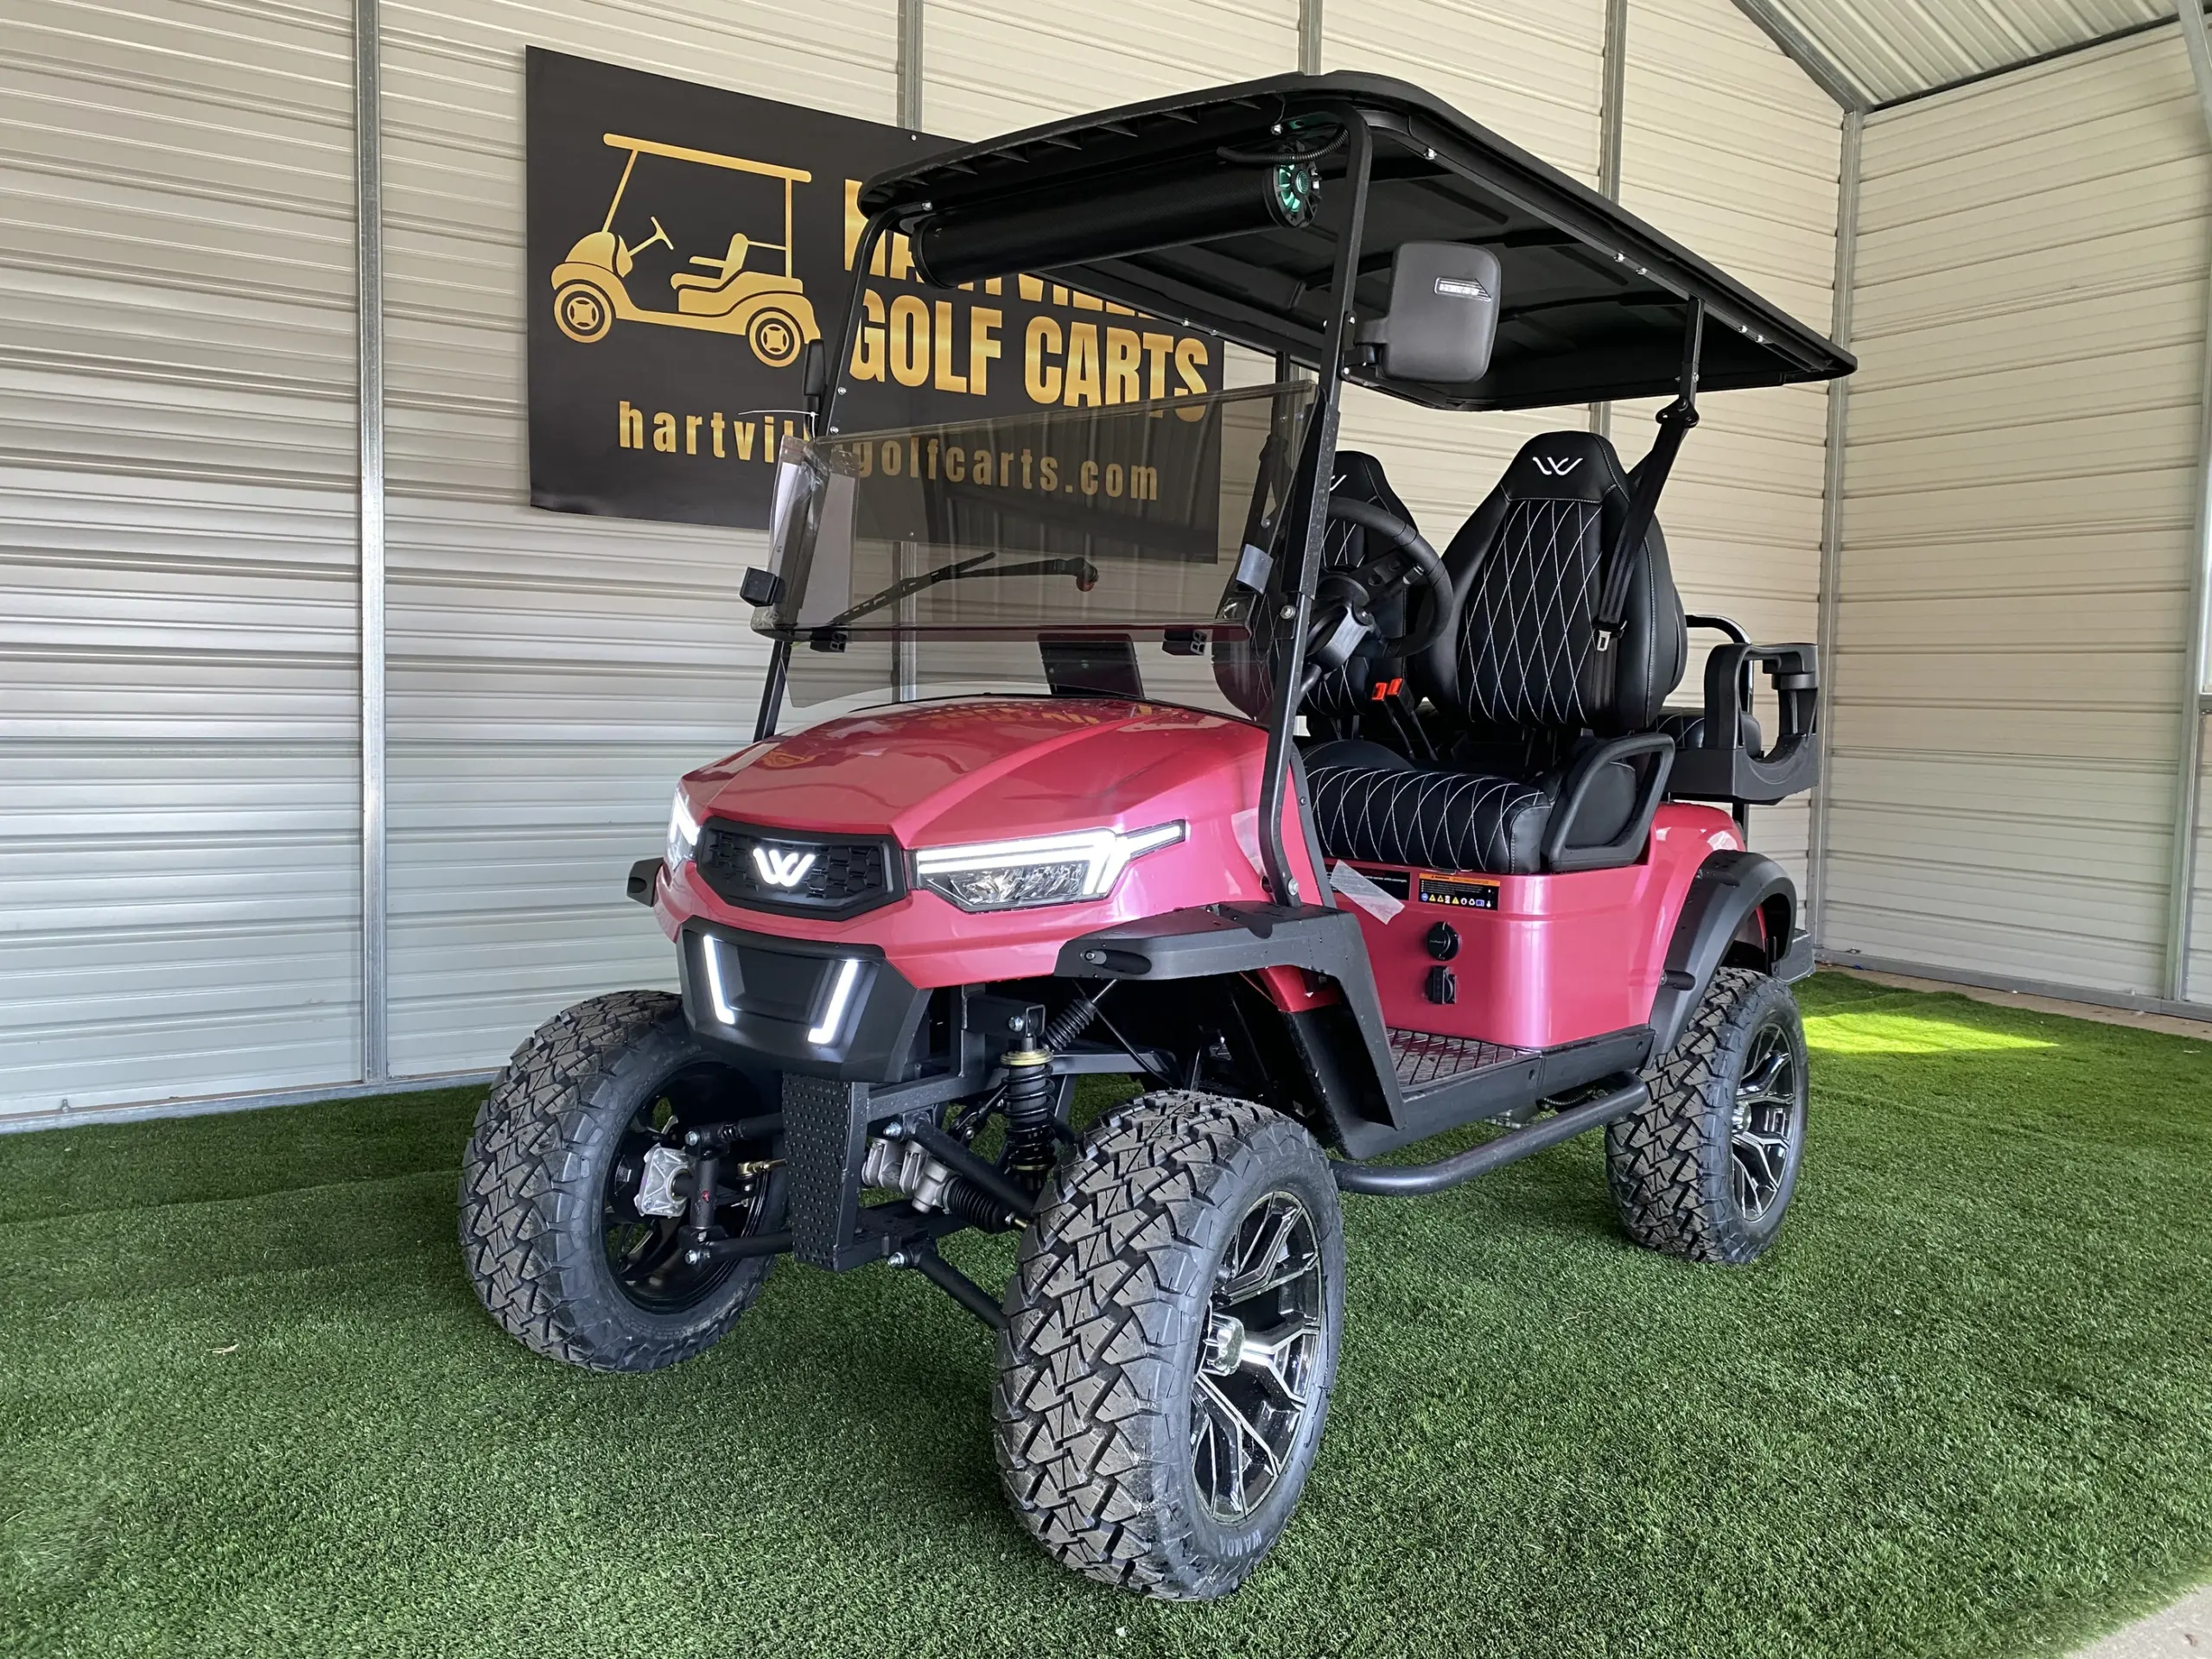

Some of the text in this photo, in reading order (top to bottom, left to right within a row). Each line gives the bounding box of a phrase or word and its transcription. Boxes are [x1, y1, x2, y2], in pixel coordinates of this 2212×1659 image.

[849, 289, 1209, 423] GOLF CARTS
[1218, 1529, 1262, 1557] WANDA
